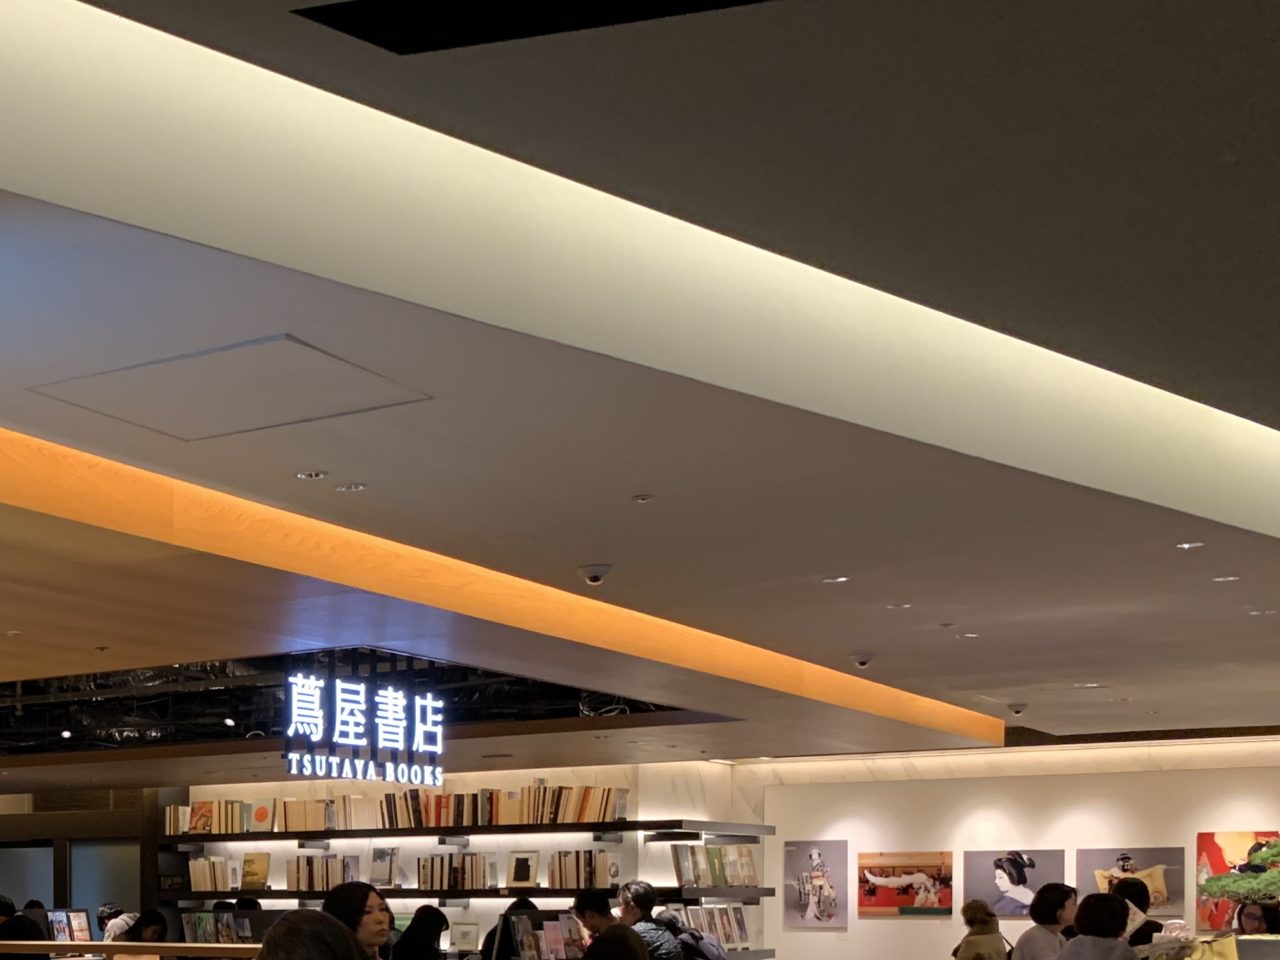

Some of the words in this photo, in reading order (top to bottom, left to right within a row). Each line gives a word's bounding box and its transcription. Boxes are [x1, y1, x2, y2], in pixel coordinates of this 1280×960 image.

[287, 672, 445, 756] 蔦屋書店
[288, 752, 377, 781] TSUTAYA
[385, 761, 444, 787] BOOKS
